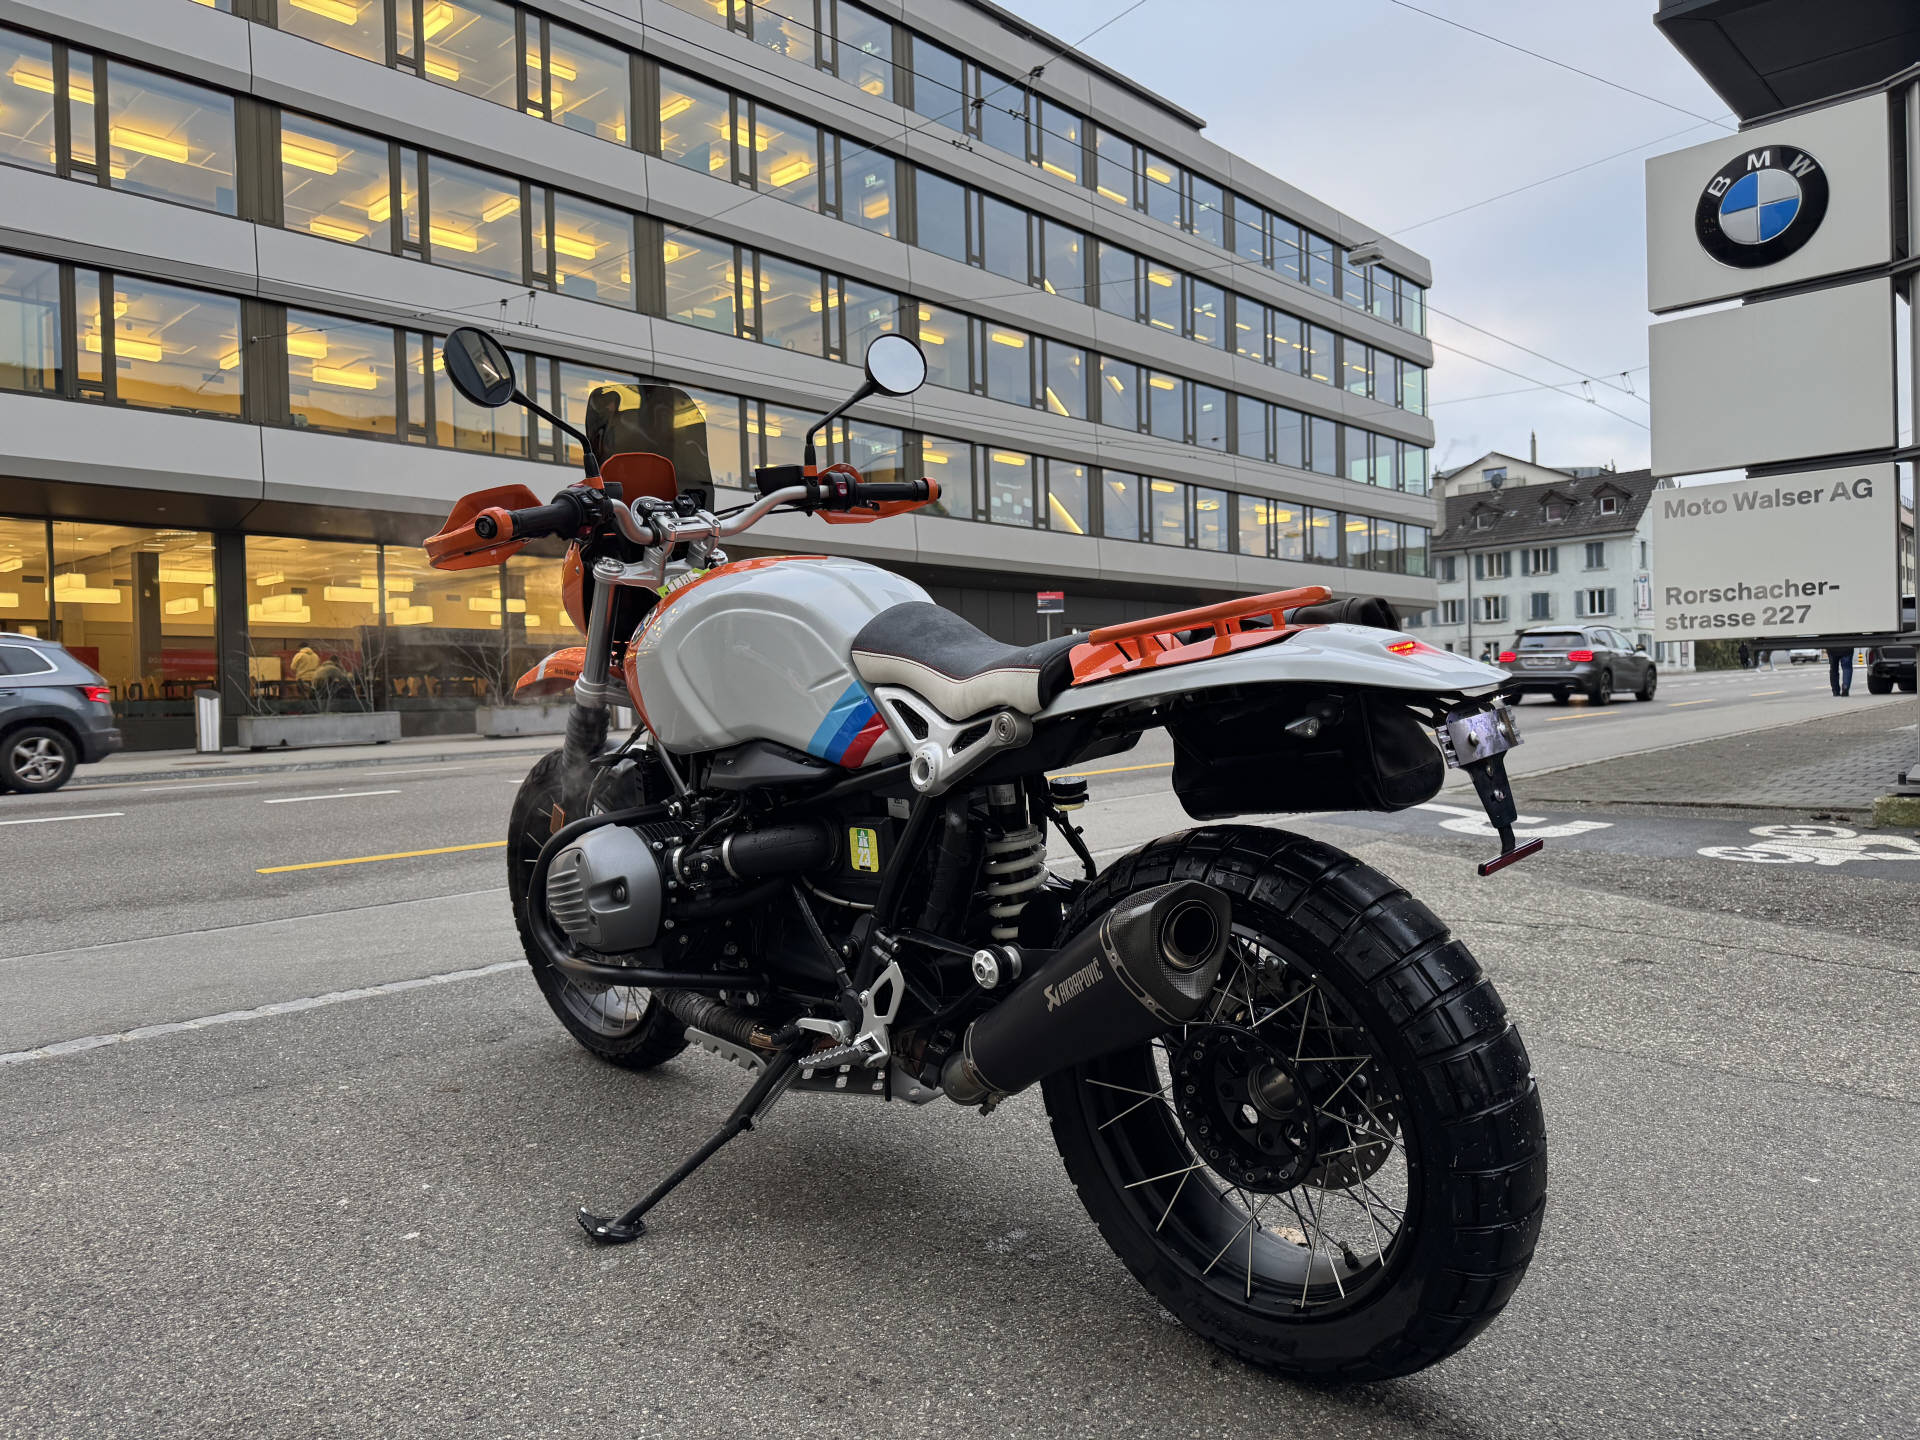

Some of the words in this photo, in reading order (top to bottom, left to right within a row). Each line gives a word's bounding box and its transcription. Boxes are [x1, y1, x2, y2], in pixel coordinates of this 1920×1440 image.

[1708, 150, 1816, 197] BMW
[1664, 497, 1728, 519] Moto
[1733, 487, 1825, 512] Walser
[1829, 478, 1873, 502] AG
[1665, 578, 1840, 605] Rorschacher-
[1665, 612, 1756, 630] strasse
[1762, 604, 1812, 626] 227
[857, 847, 871, 866] 23
